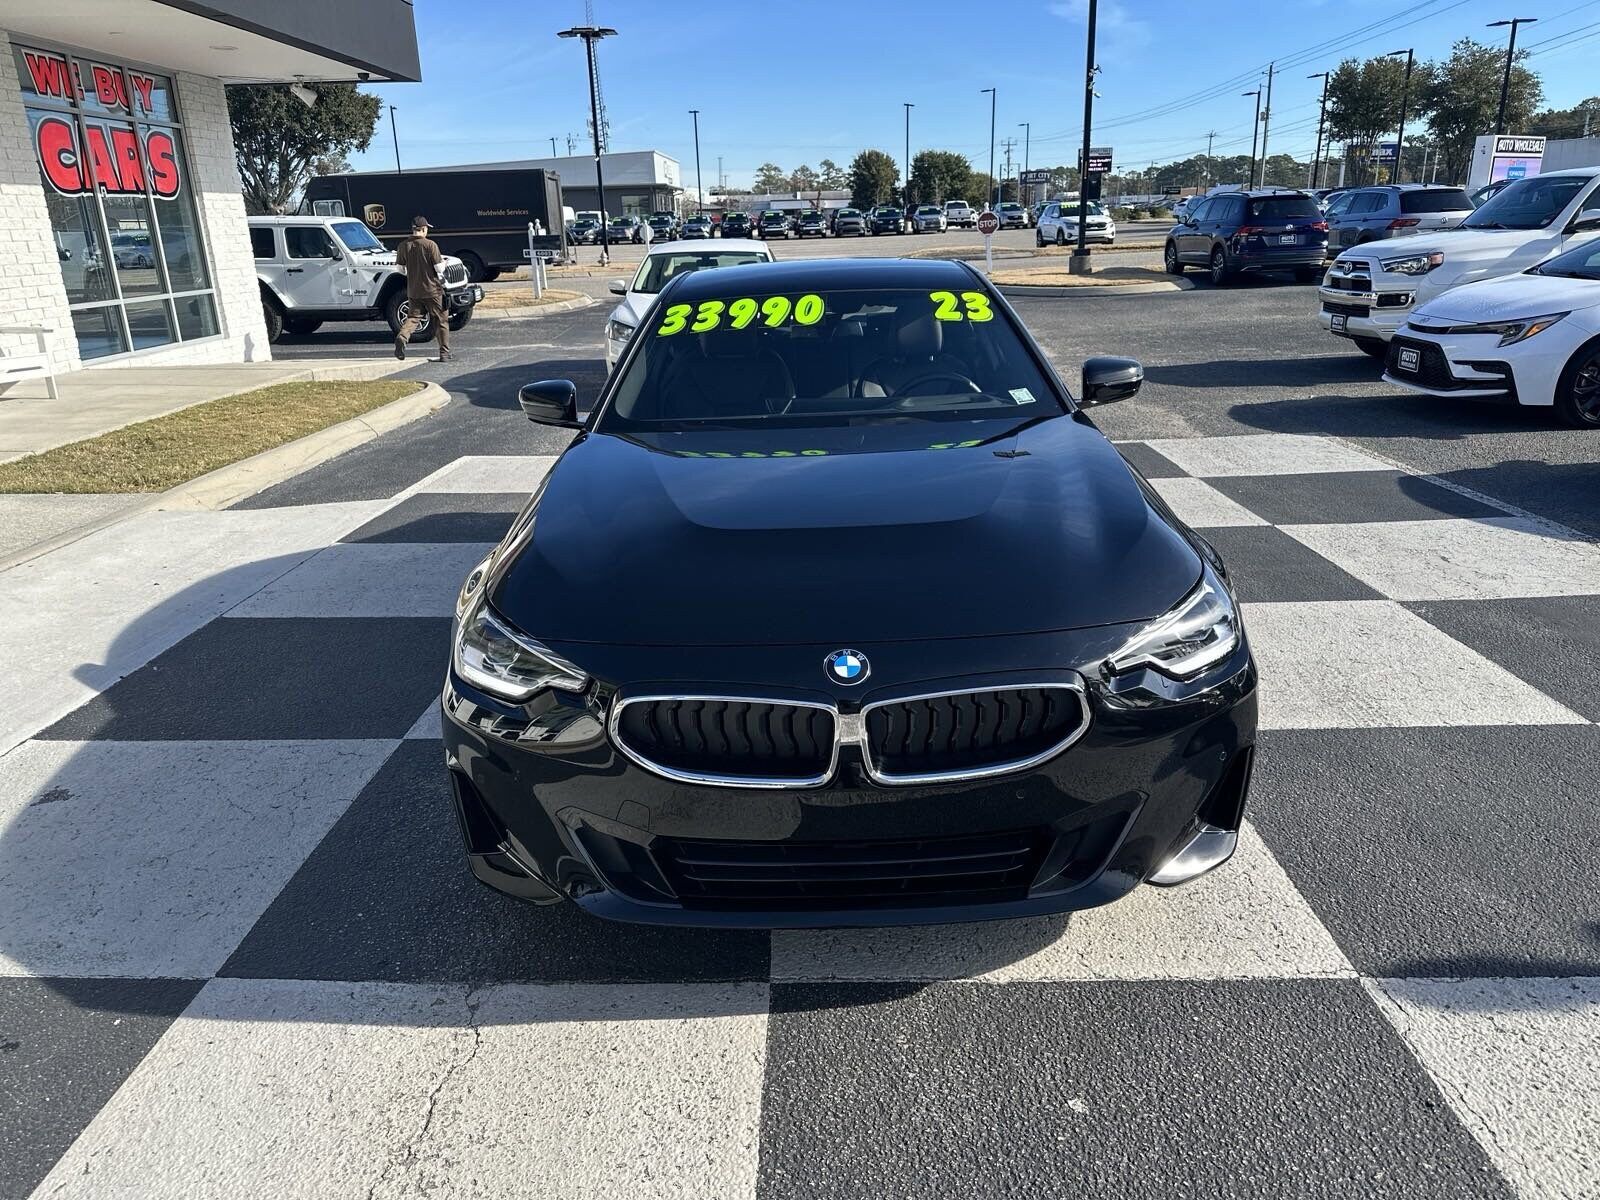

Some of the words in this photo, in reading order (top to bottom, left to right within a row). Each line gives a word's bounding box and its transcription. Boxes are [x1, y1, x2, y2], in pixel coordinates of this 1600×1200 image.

[22, 49, 85, 101] WE
[91, 64, 154, 113] BUY
[1498, 139, 1513, 151] AUTO
[1514, 140, 1544, 152] WHOLESALE
[36, 116, 180, 200] CARS
[366, 210, 384, 224] ups
[477, 209, 505, 217] Worldwide
[507, 208, 529, 216] Services
[979, 219, 997, 228] STOP
[930, 290, 994, 322] 23
[657, 294, 825, 336] 33990
[1402, 351, 1417, 362] AUTO
[830, 649, 865, 662] BMW
